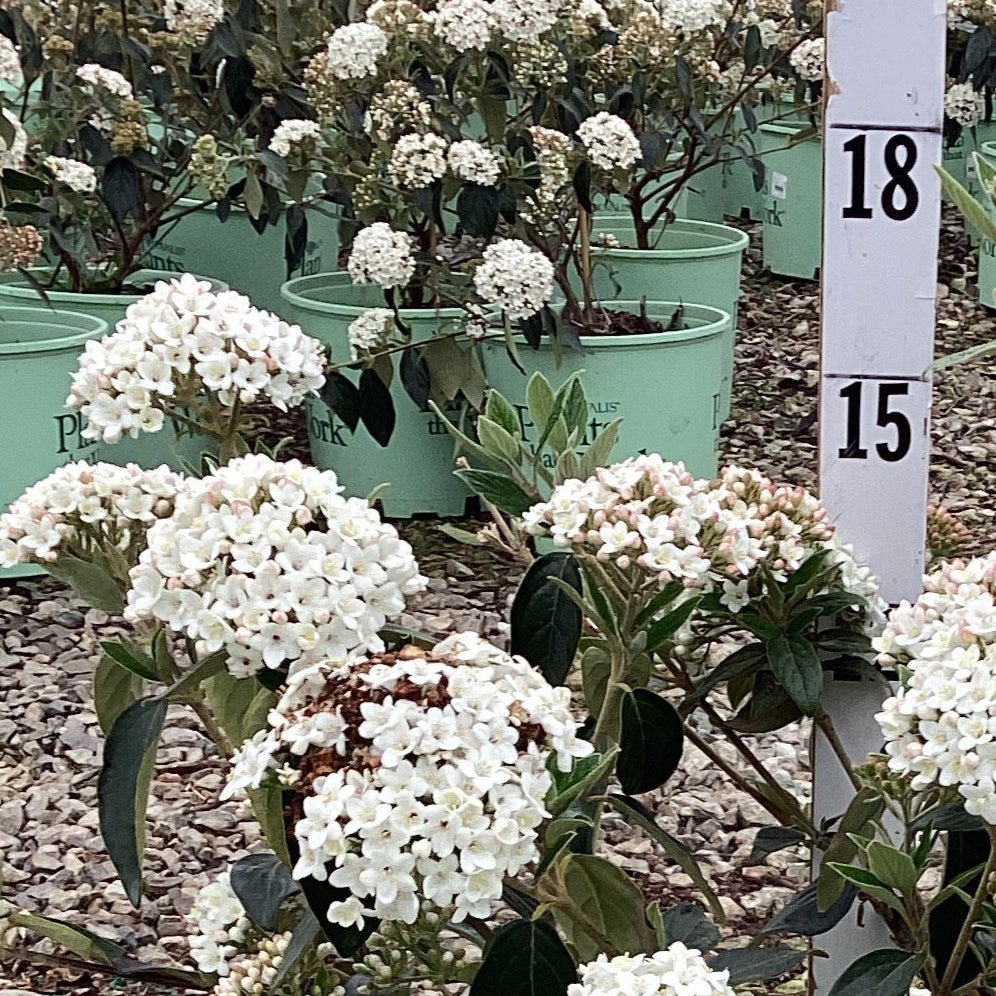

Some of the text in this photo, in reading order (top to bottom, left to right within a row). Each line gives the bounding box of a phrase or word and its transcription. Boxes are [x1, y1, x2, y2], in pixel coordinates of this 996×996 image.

[841, 133, 919, 221] 18
[304, 402, 348, 447] ork
[838, 381, 911, 462] 15
